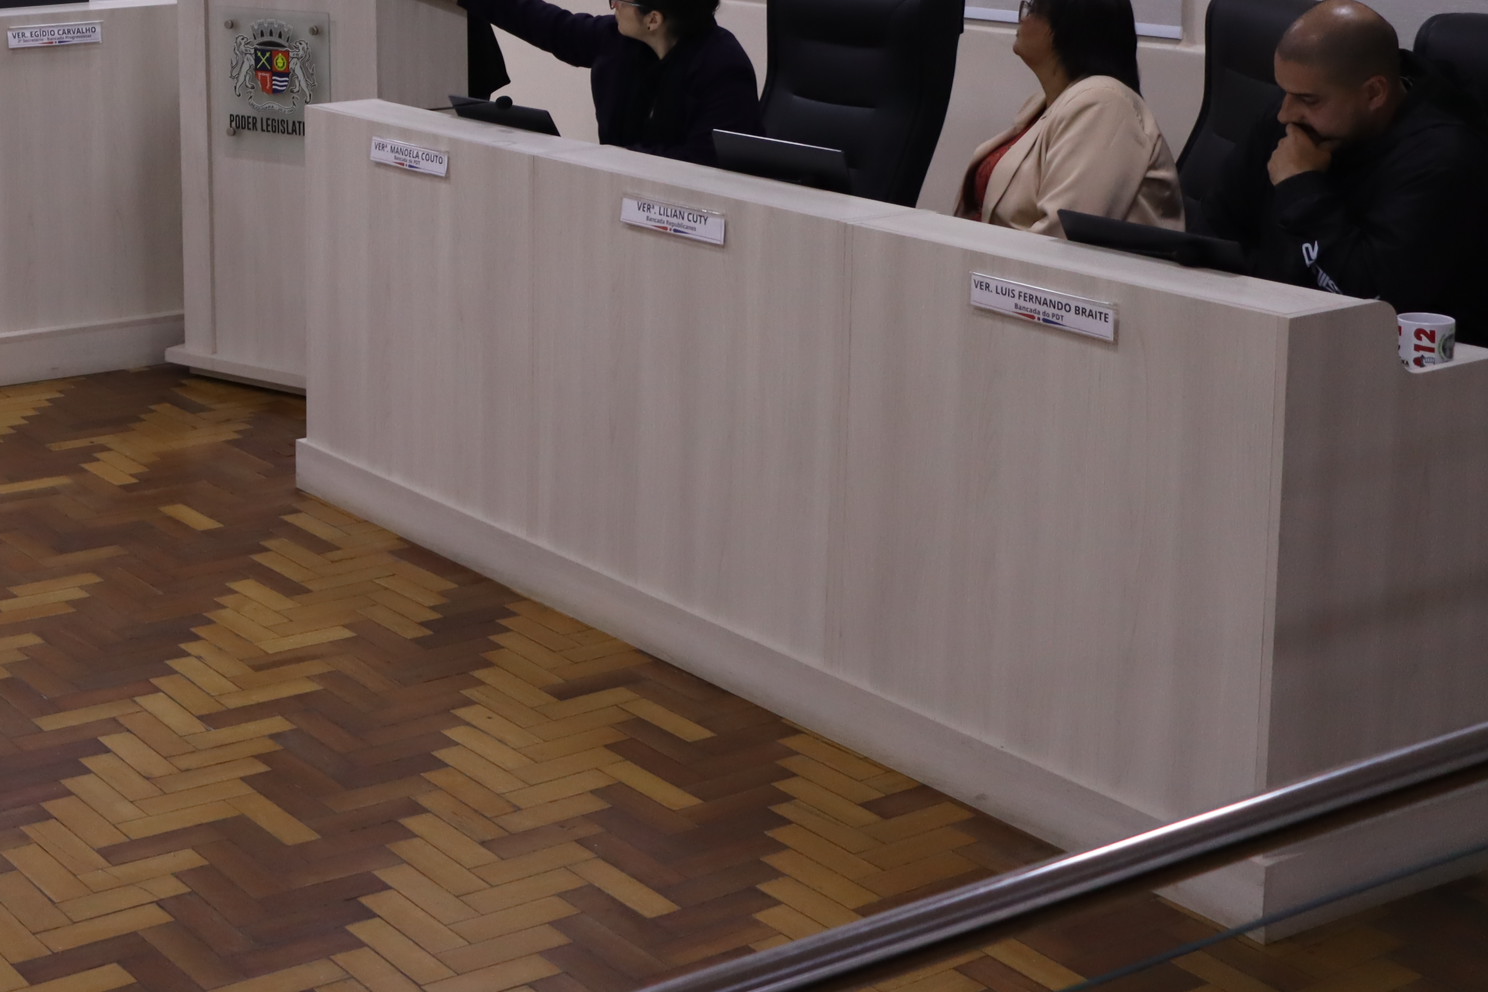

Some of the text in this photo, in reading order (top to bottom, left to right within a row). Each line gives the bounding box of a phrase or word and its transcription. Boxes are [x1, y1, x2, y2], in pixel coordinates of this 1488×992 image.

[12, 26, 97, 39] VER. EGÍDIO CARVALHO
[229, 113, 306, 136] PODER LEGISLATI
[390, 145, 420, 160] MANOELA
[420, 153, 443, 165] COUTO
[645, 215, 666, 224] Bancada
[659, 206, 685, 221] LILIAN
[687, 212, 709, 226] CUTY
[973, 279, 1109, 323] VER. LUIS FERNANDO BRAITE
[1014, 302, 1065, 322] Bancada do PDT
[1413, 327, 1436, 353] 12
